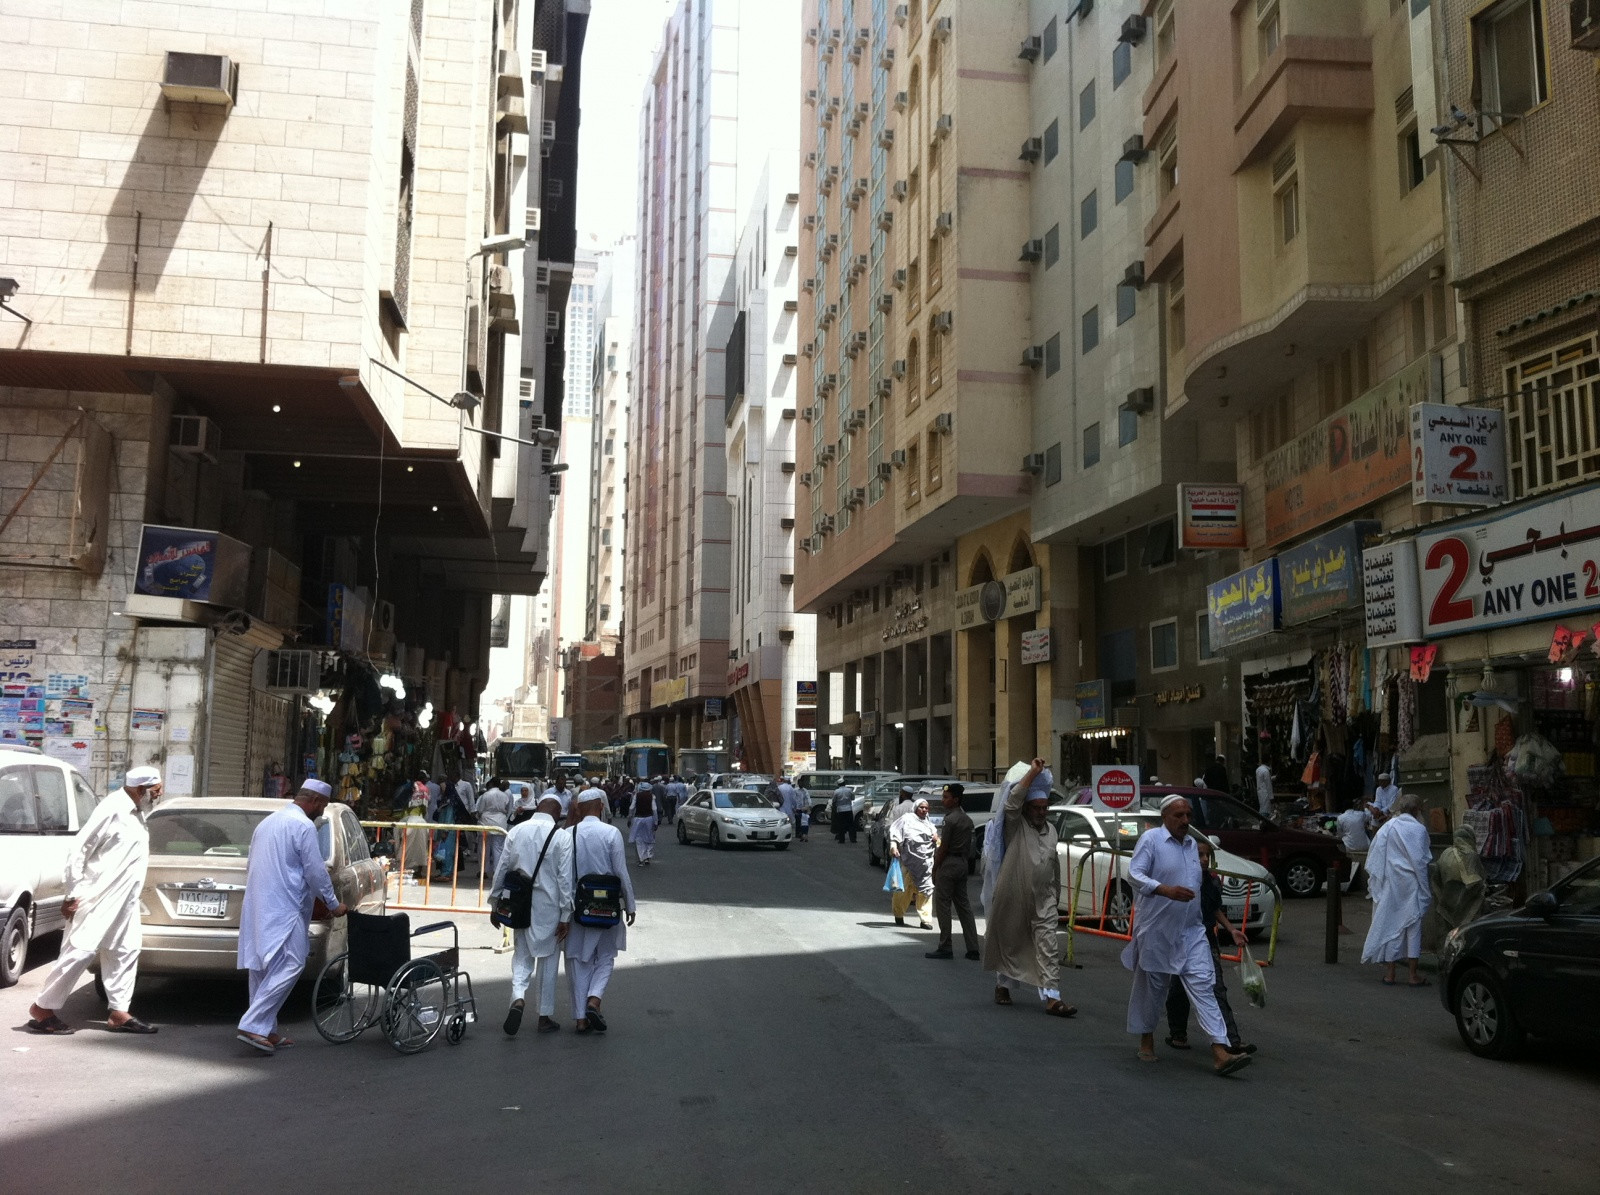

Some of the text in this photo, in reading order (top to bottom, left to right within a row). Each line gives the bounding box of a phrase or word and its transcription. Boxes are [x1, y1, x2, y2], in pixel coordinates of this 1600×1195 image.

[1428, 416, 1498, 433] مركز السبحي
[1440, 432, 1487, 446] ANY ONE
[1415, 446, 1424, 482] 2
[1449, 445, 1494, 480] 2 S.R
[1365, 552, 1393, 571] تخفيضات
[1366, 569, 1394, 588] تخفيضات
[1425, 536, 1475, 626] 2
[1366, 586, 1395, 605] تخفيضات
[1483, 583, 1524, 616] ANY
[1531, 572, 1577, 607] ONE
[1367, 602, 1396, 621] تخفيضات
[1368, 619, 1397, 639] تخفيضات
[3, 654, 32, 668] اوتيس
[179, 904, 200, 914] 1762
